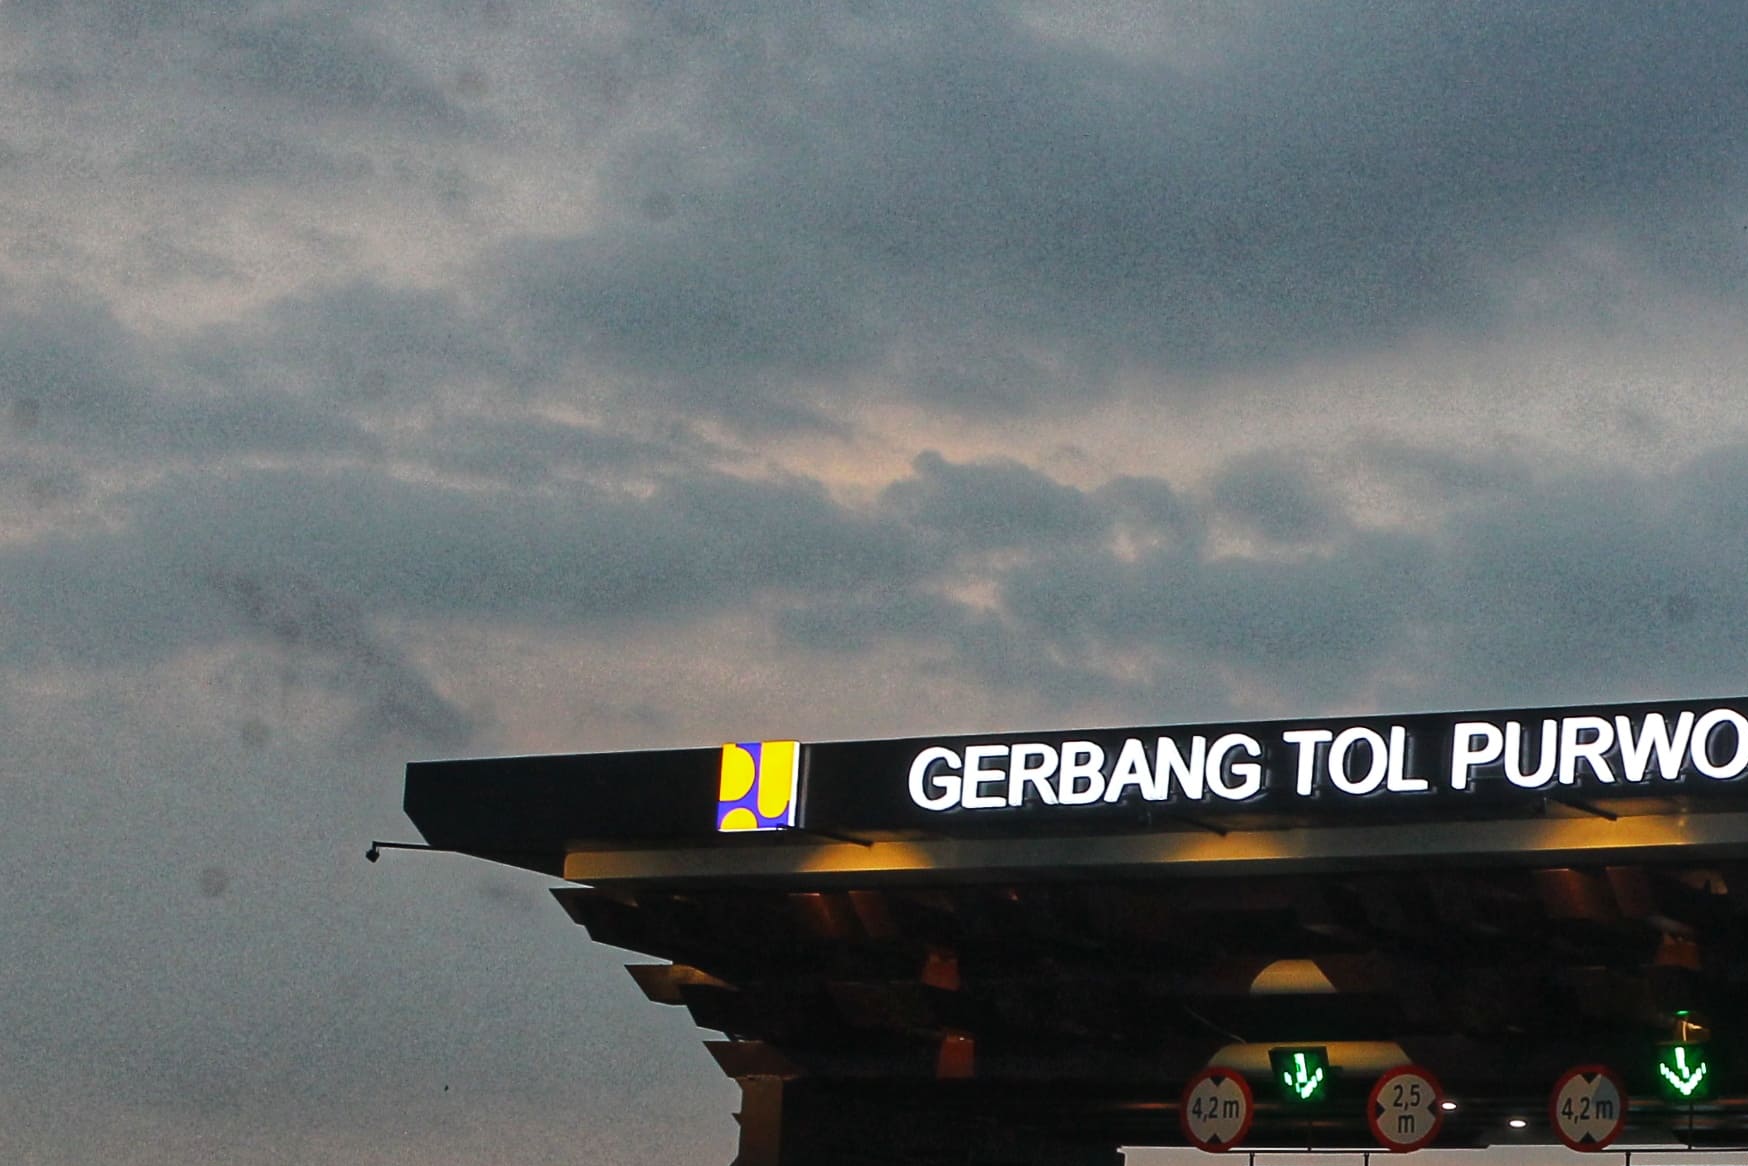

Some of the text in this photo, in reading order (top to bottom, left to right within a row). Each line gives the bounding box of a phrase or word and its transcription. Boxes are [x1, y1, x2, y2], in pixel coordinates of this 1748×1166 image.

[907, 732, 1263, 812] GERBANG
[1282, 724, 1429, 797] TOL
[1192, 1096, 1241, 1123] 4,2 m
[1393, 1084, 1422, 1111] 2,5
[1561, 1096, 1615, 1124] 4,2 m
[1397, 1114, 1416, 1134] m
